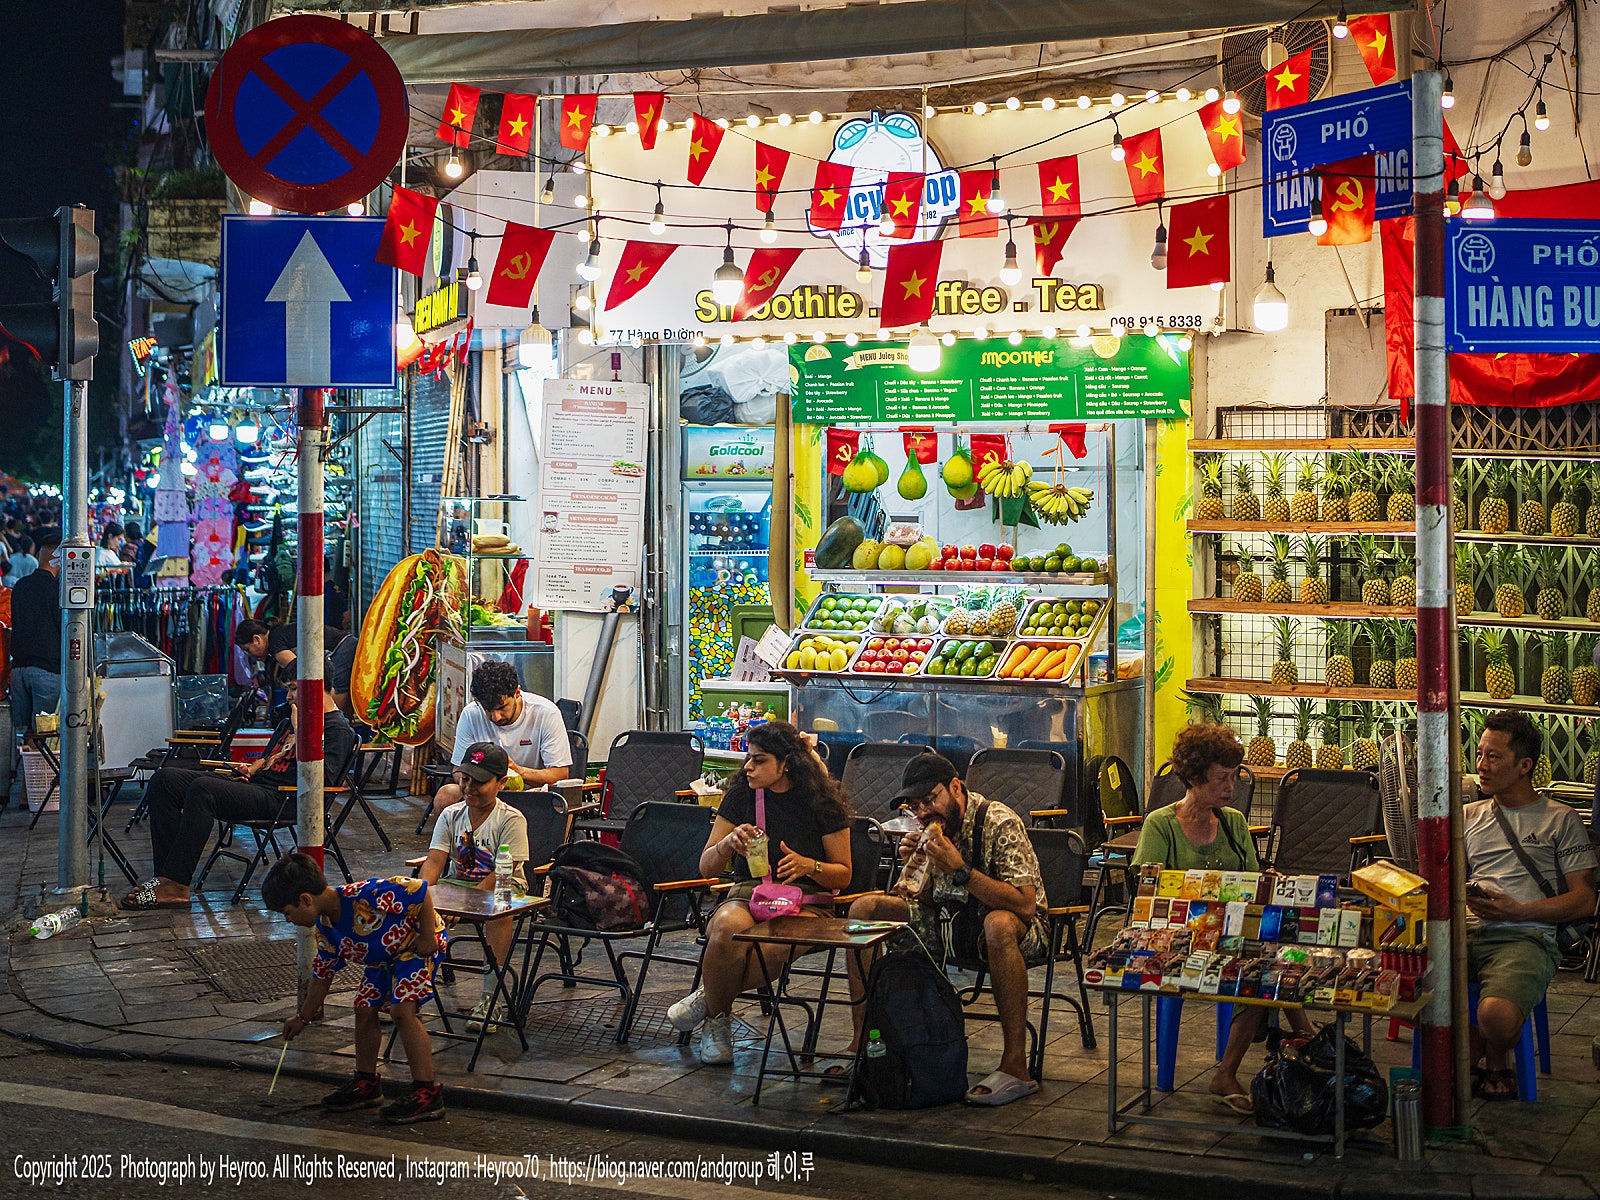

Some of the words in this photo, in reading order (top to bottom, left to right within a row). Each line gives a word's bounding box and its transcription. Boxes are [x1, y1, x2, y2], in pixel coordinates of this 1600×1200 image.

[1321, 106, 1370, 144] PHỐ
[1533, 236, 1600, 266] PHỐ
[1032, 277, 1102, 314] Tea
[1467, 275, 1555, 328] HÀNG
[1168, 314, 1203, 328] 8338
[859, 352, 877, 362] MENU
[878, 351, 895, 362] Juicy
[896, 351, 909, 361] Sho
[980, 350, 1055, 368] SMOOTHIES
[580, 385, 612, 396] MENU
[709, 445, 755, 457] Goldcool
[65, 708, 89, 729] C2
